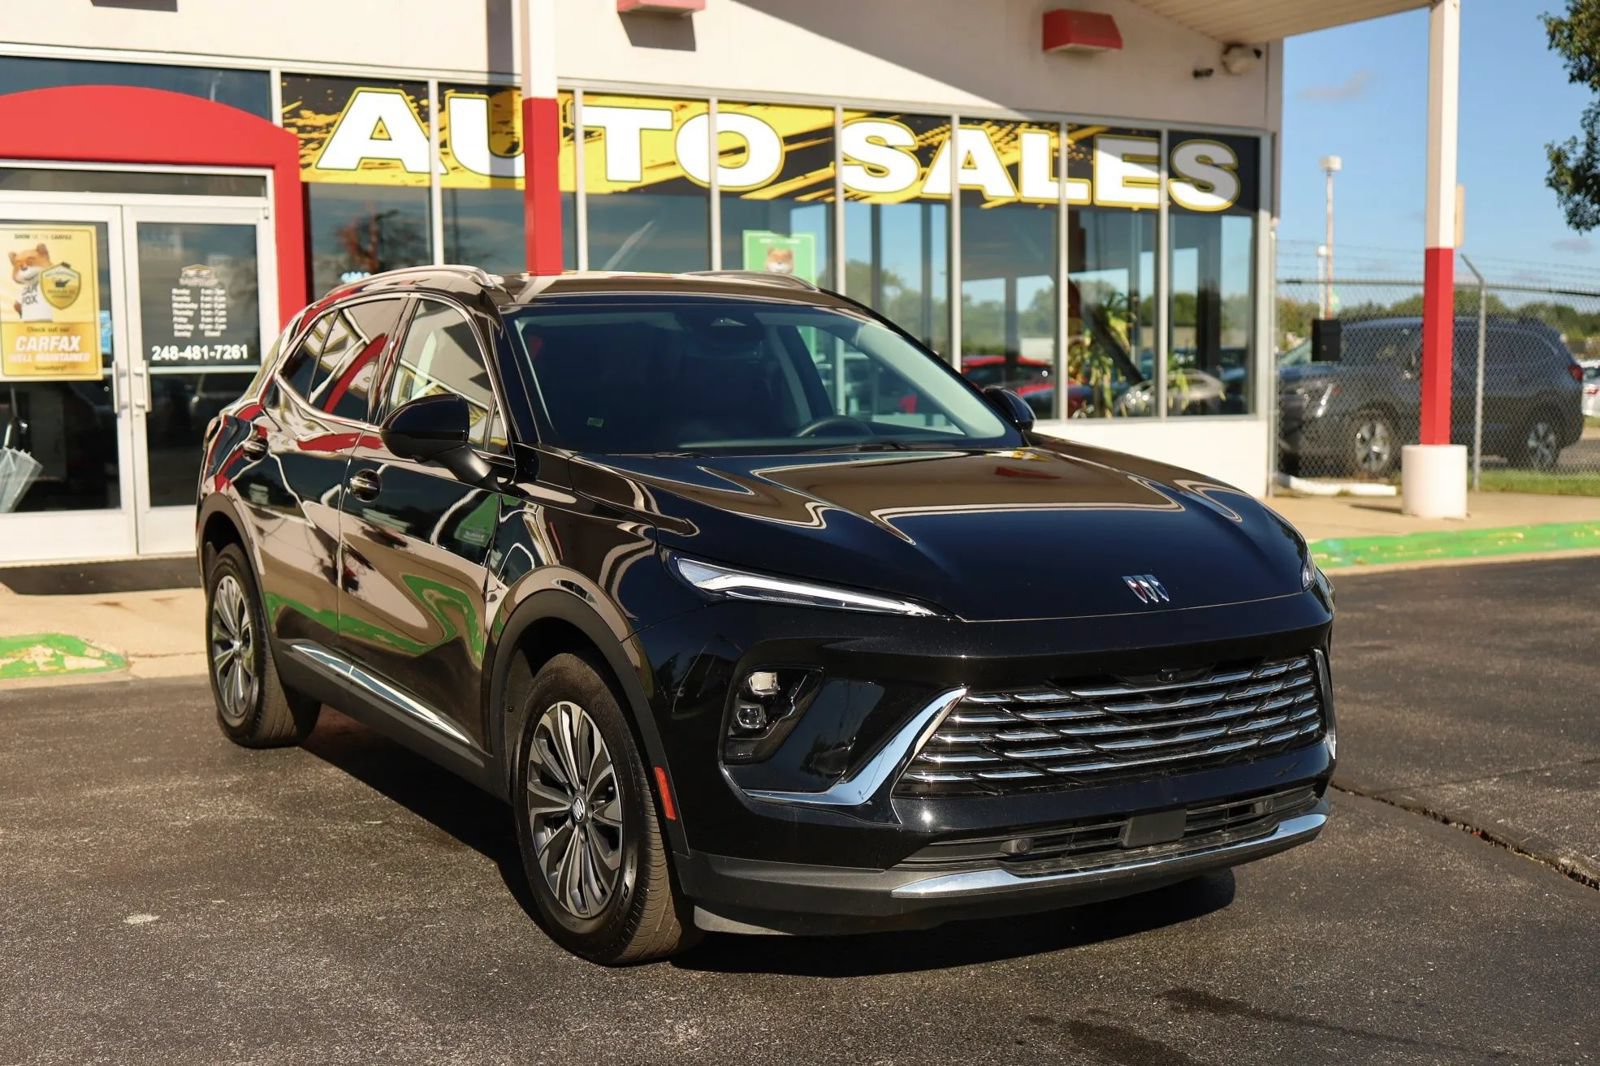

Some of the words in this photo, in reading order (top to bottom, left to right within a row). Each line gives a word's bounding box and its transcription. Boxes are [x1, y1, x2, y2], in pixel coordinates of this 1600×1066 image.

[314, 87, 785, 192] AUTO
[841, 117, 1241, 211] SALES
[15, 335, 81, 352] CARFAX
[152, 344, 248, 361] 248-481-7261
